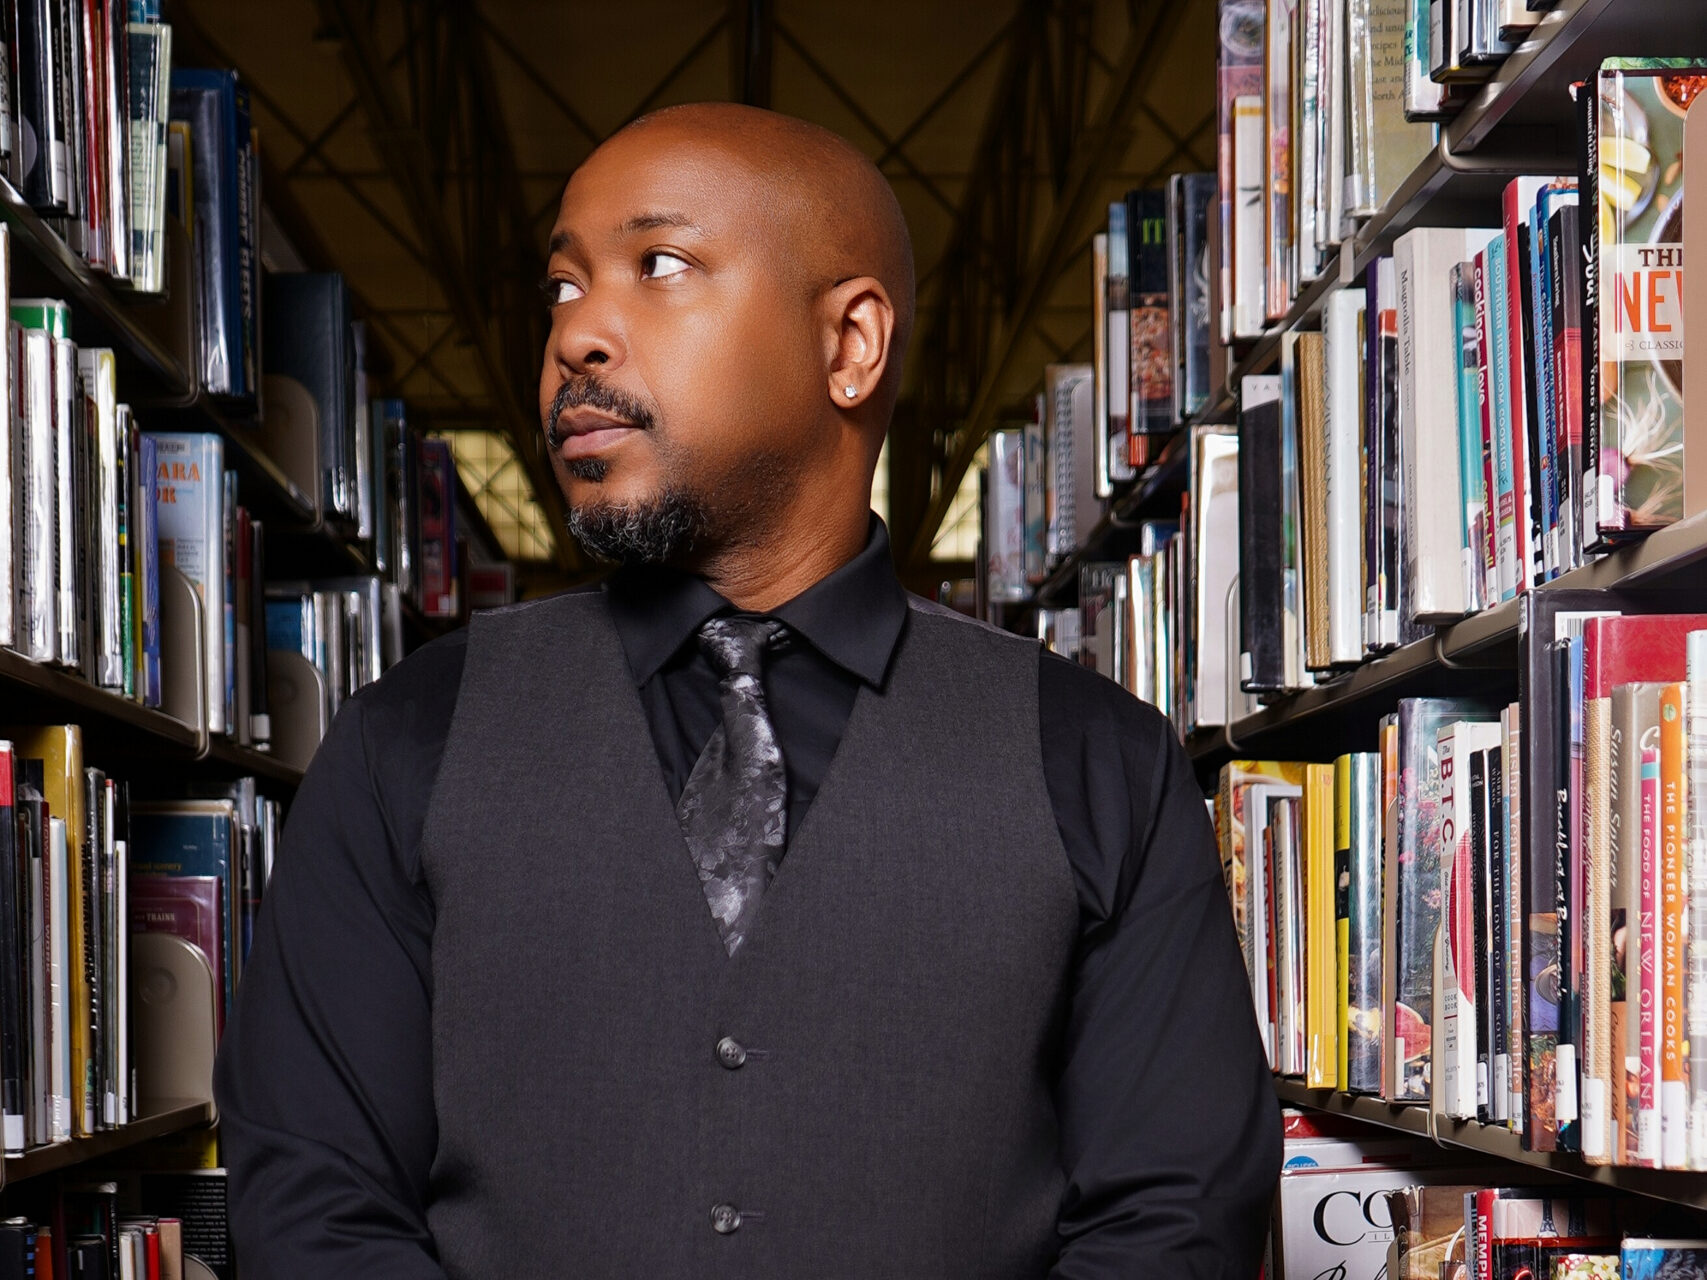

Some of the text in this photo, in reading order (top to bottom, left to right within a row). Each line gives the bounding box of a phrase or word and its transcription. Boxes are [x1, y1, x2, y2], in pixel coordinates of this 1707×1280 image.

[1401, 269, 1410, 334] Magnolia
[1495, 257, 1504, 330] SOUTHERN
[1614, 271, 1682, 333] NE
[1496, 333, 1505, 404] HEIRLOOM
[1610, 725, 1622, 801] Susan
[1441, 756, 1454, 853] B.T.C.
[1643, 794, 1651, 822] THE
[1510, 809, 1521, 922] Yearwood
[1643, 828, 1651, 873] FOOD
[1556, 788, 1568, 1001] Breakfast at Brennan's
[1643, 878, 1651, 899] OF
[1666, 782, 1676, 1061] THE PIONEER WOMAN COOKS
[1495, 951, 1500, 969] OF
